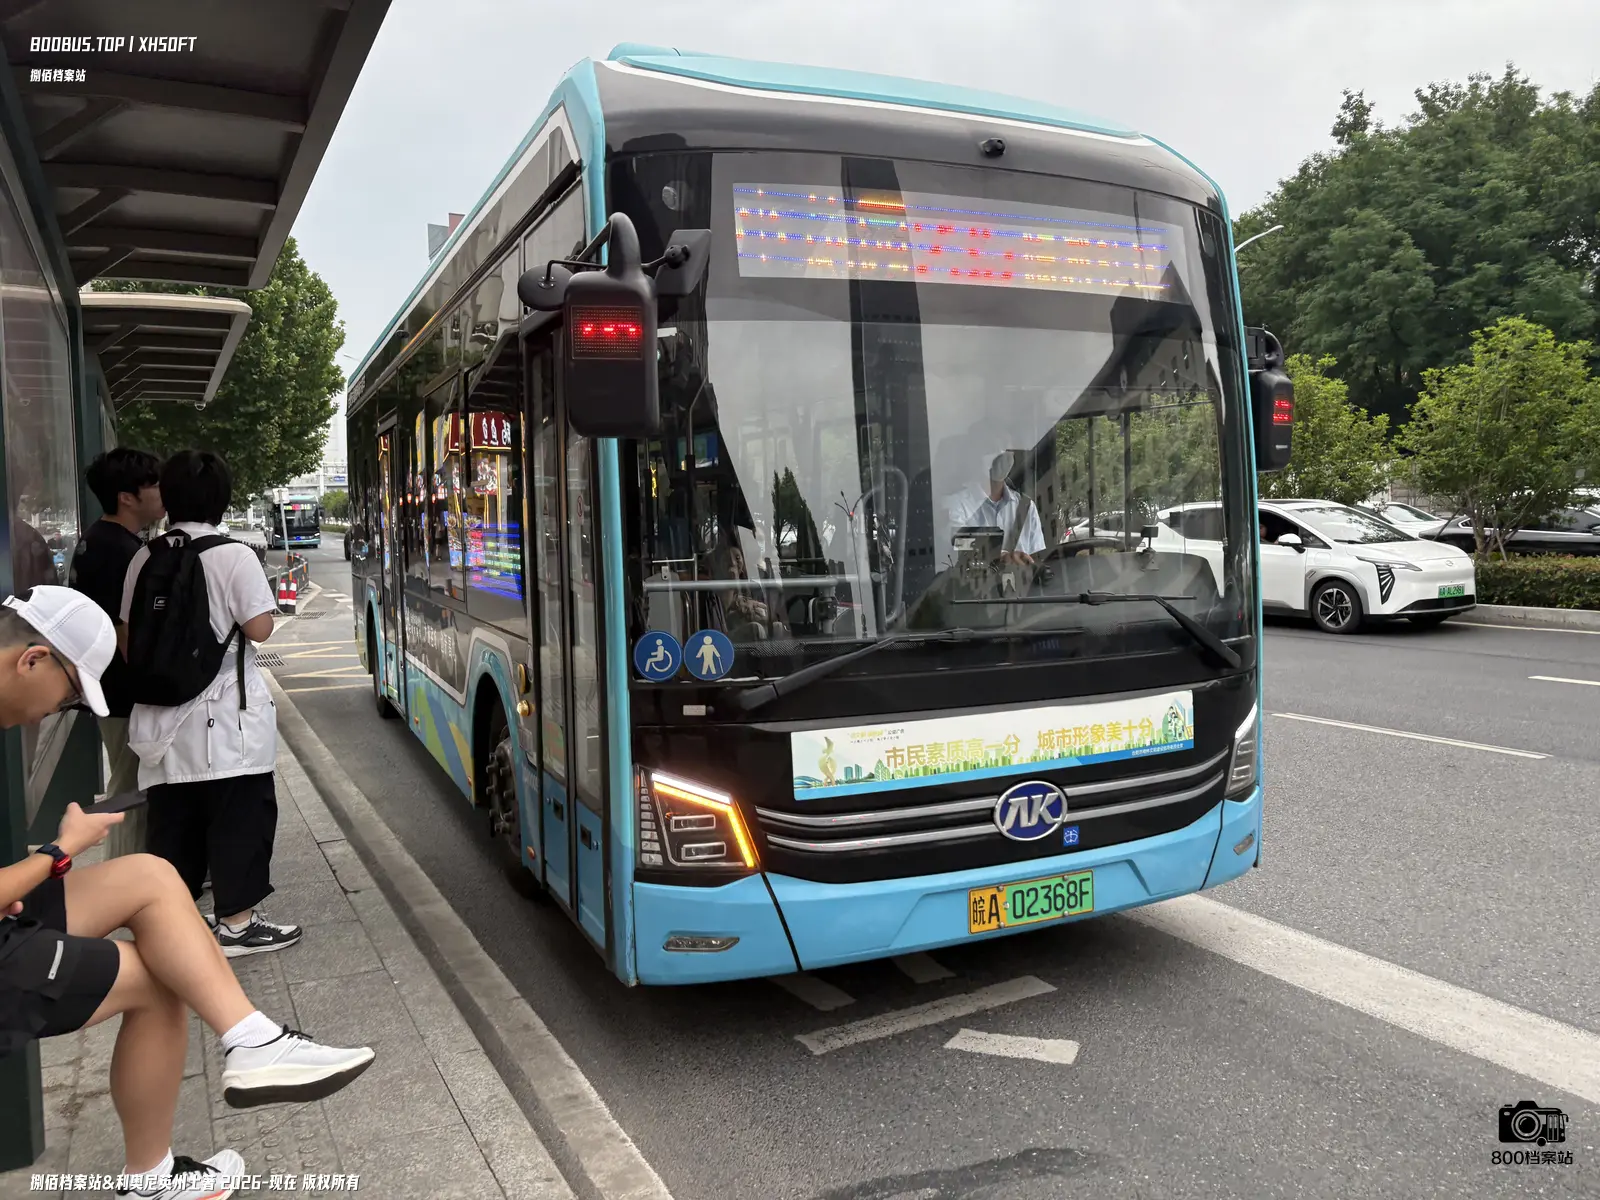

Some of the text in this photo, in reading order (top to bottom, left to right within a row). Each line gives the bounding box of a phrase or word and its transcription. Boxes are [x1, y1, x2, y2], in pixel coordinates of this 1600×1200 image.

[885, 716, 1154, 769] 市民素质高一分 城市形象美十分
